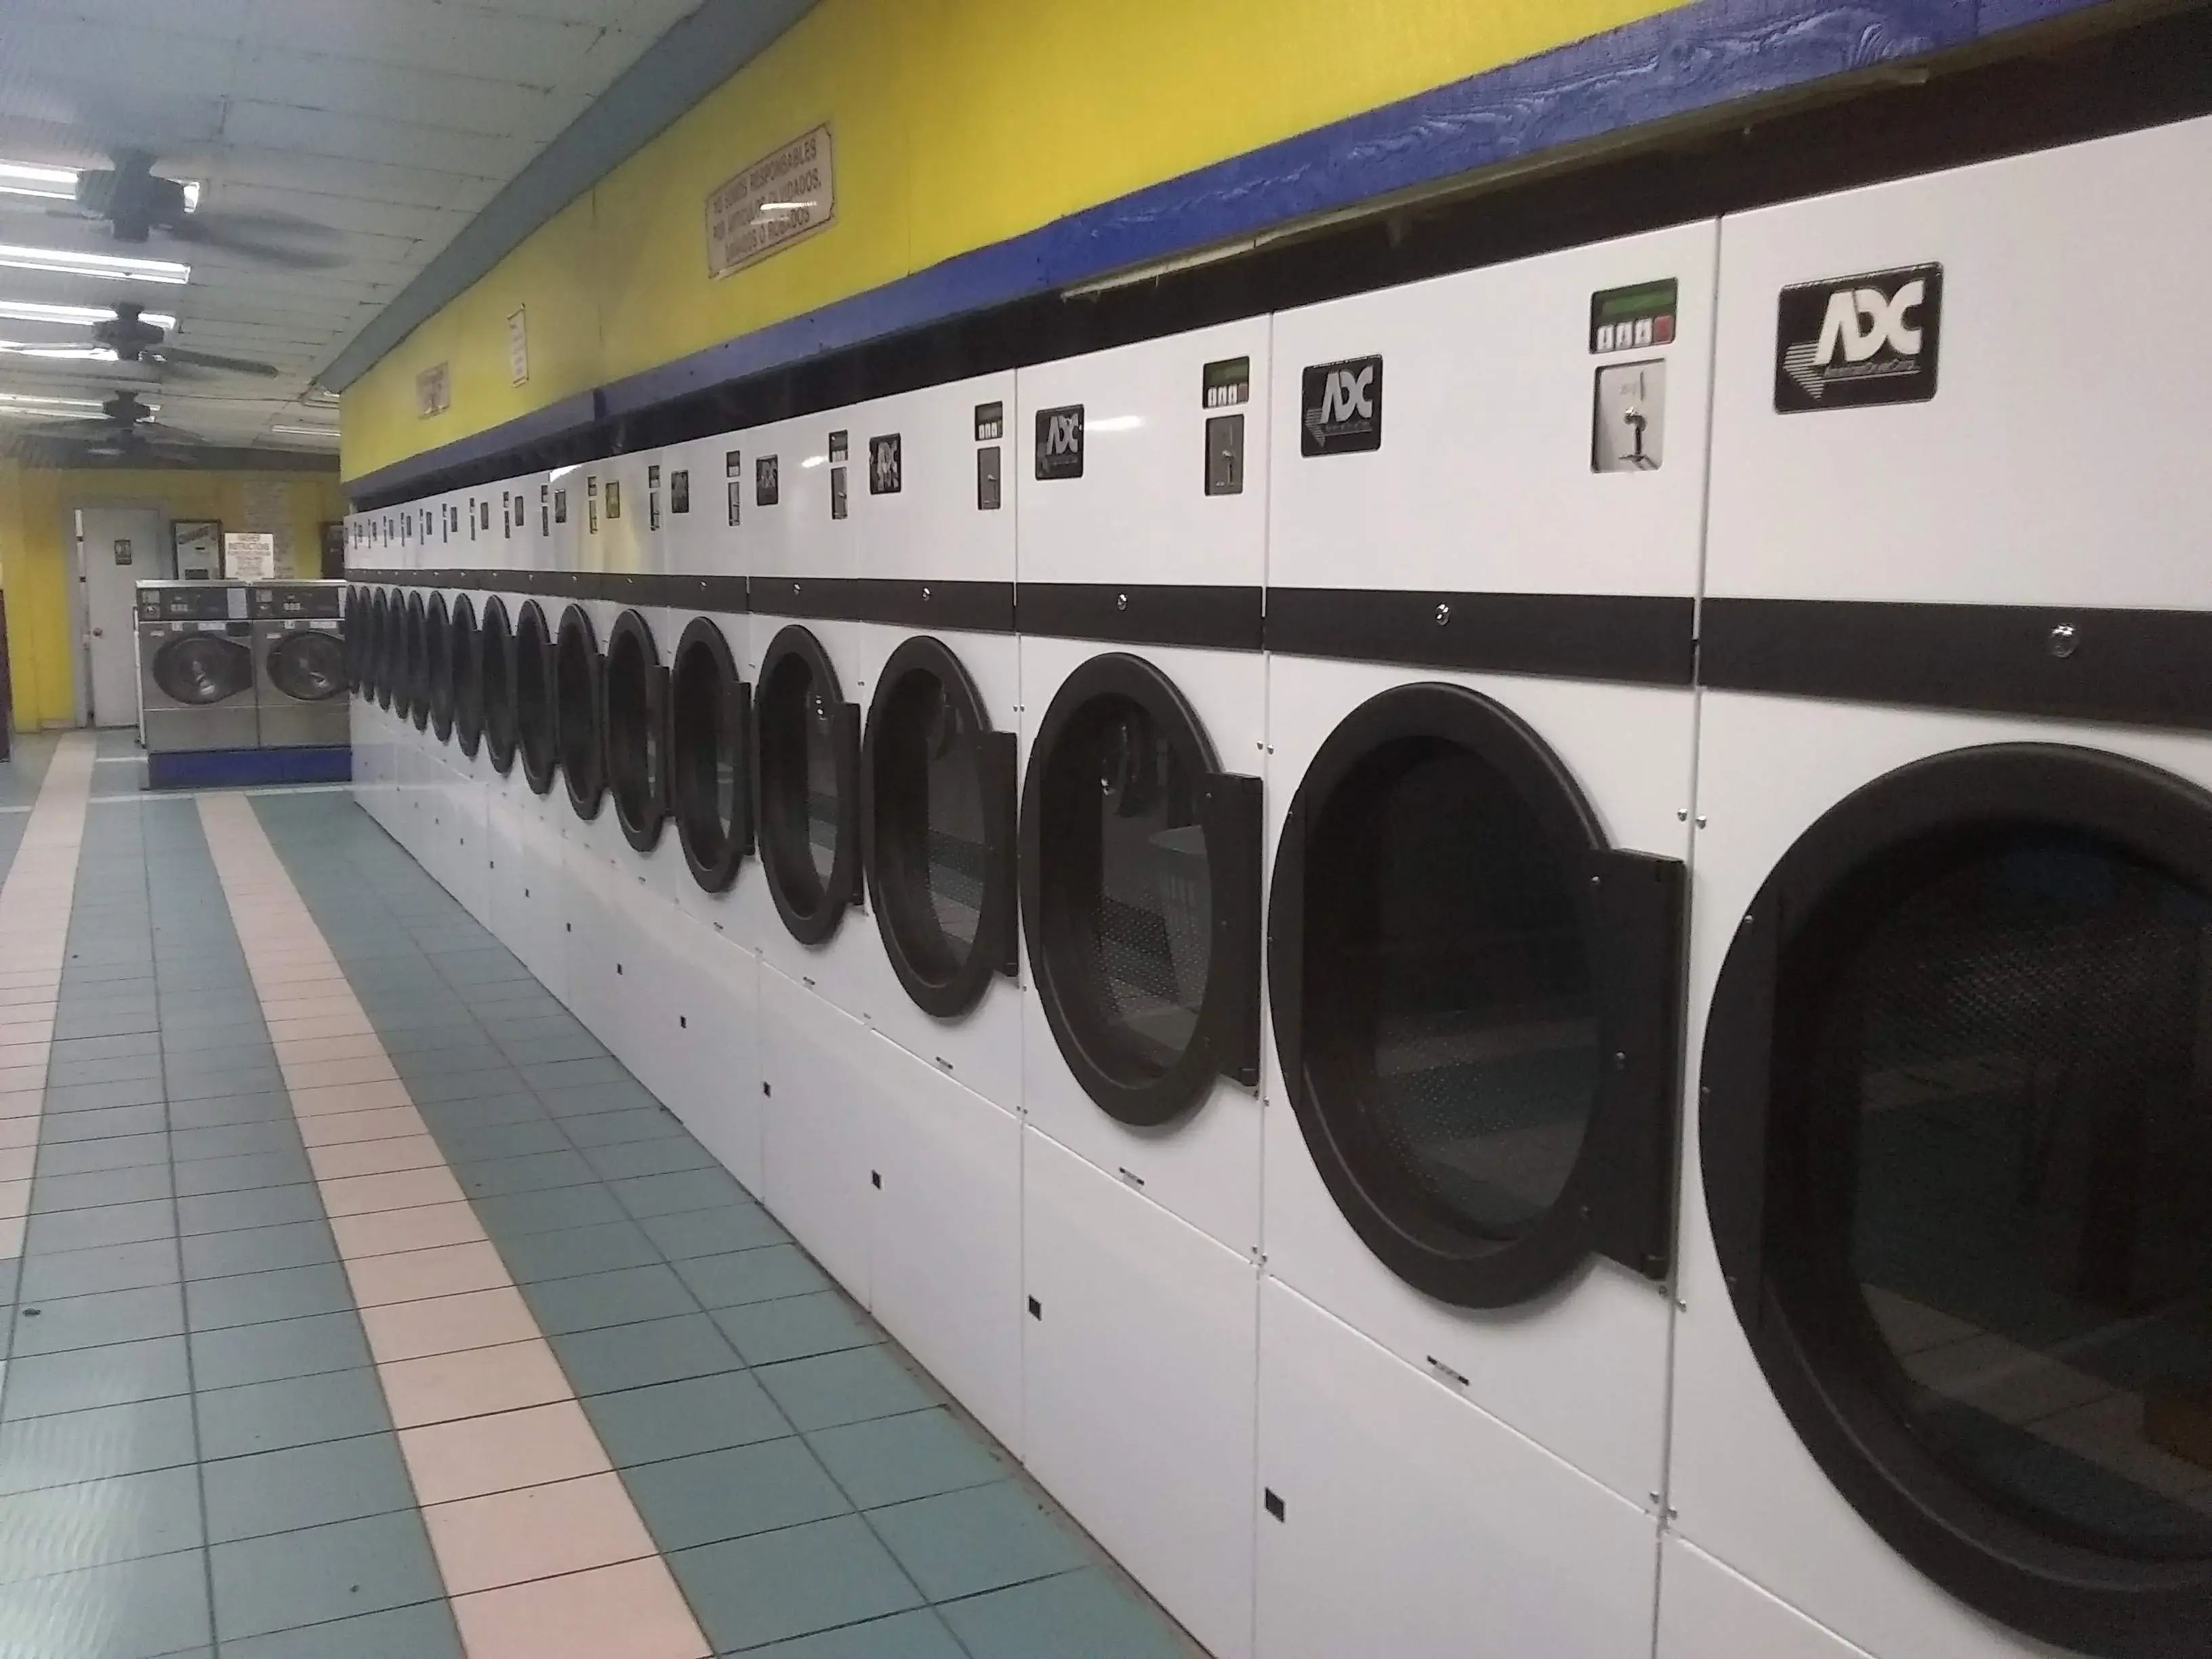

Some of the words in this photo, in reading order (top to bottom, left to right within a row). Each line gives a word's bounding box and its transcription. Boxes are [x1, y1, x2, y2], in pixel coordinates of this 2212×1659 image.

[1814, 279, 1925, 365] ADC
[1320, 366, 1374, 424] ADC
[1046, 413, 1079, 455] ADC
